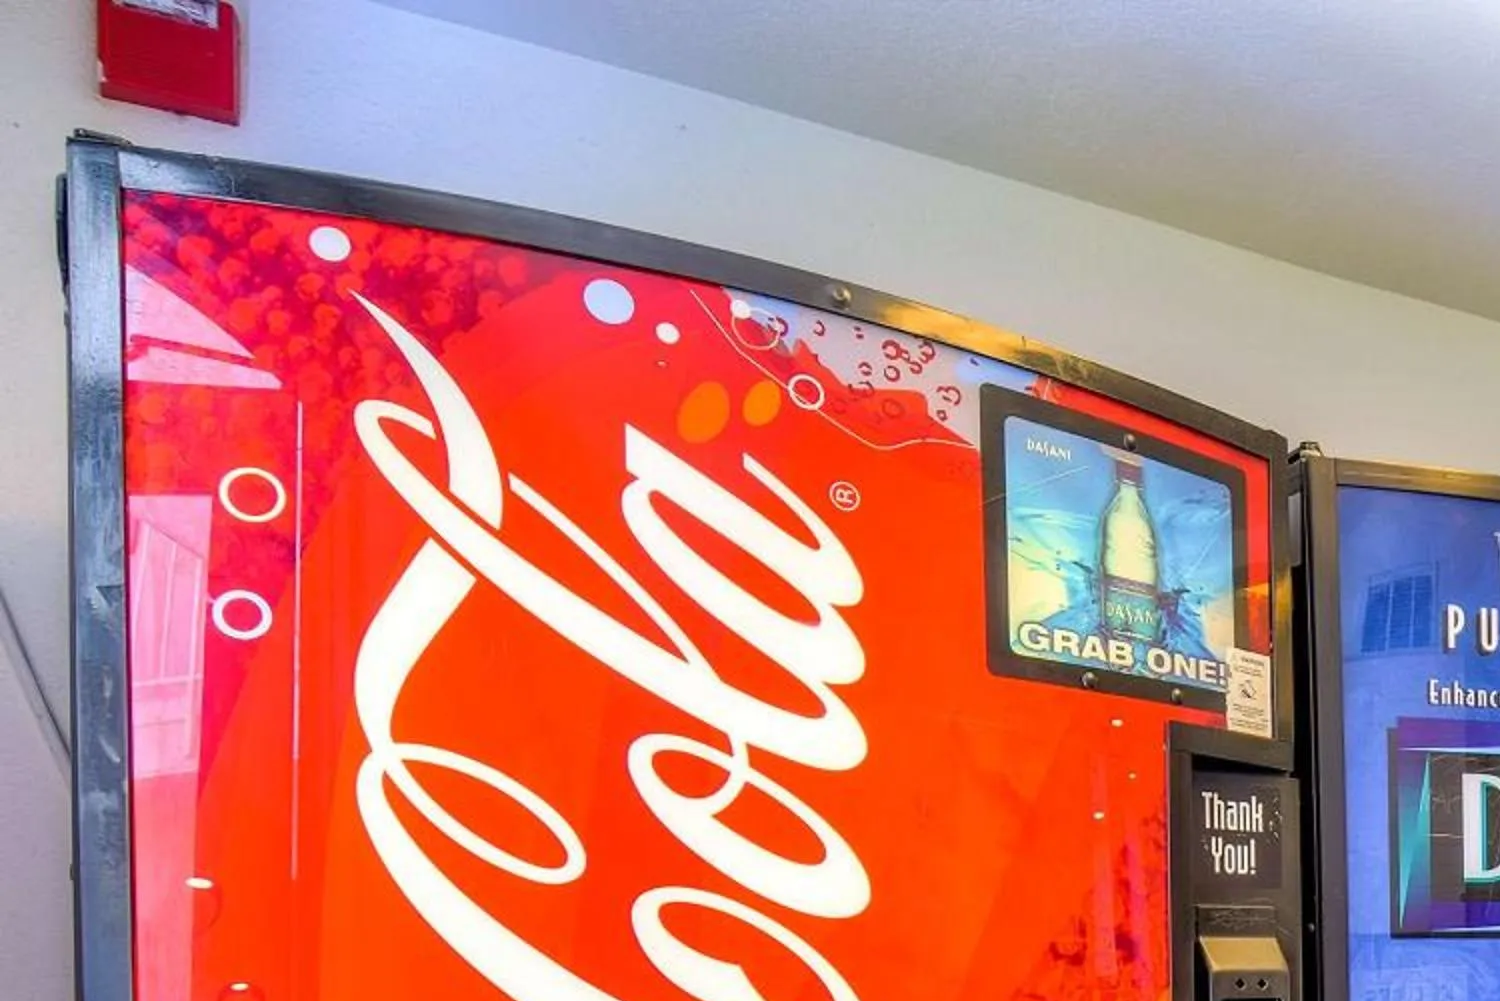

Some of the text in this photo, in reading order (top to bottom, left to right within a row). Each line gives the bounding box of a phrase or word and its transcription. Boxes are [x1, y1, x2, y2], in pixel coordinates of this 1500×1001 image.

[1026, 437, 1073, 462] DASANI
[1018, 621, 1229, 687] GRAB ONE!
[1200, 790, 1264, 833] Thank
[1210, 835, 1257, 875] You!
